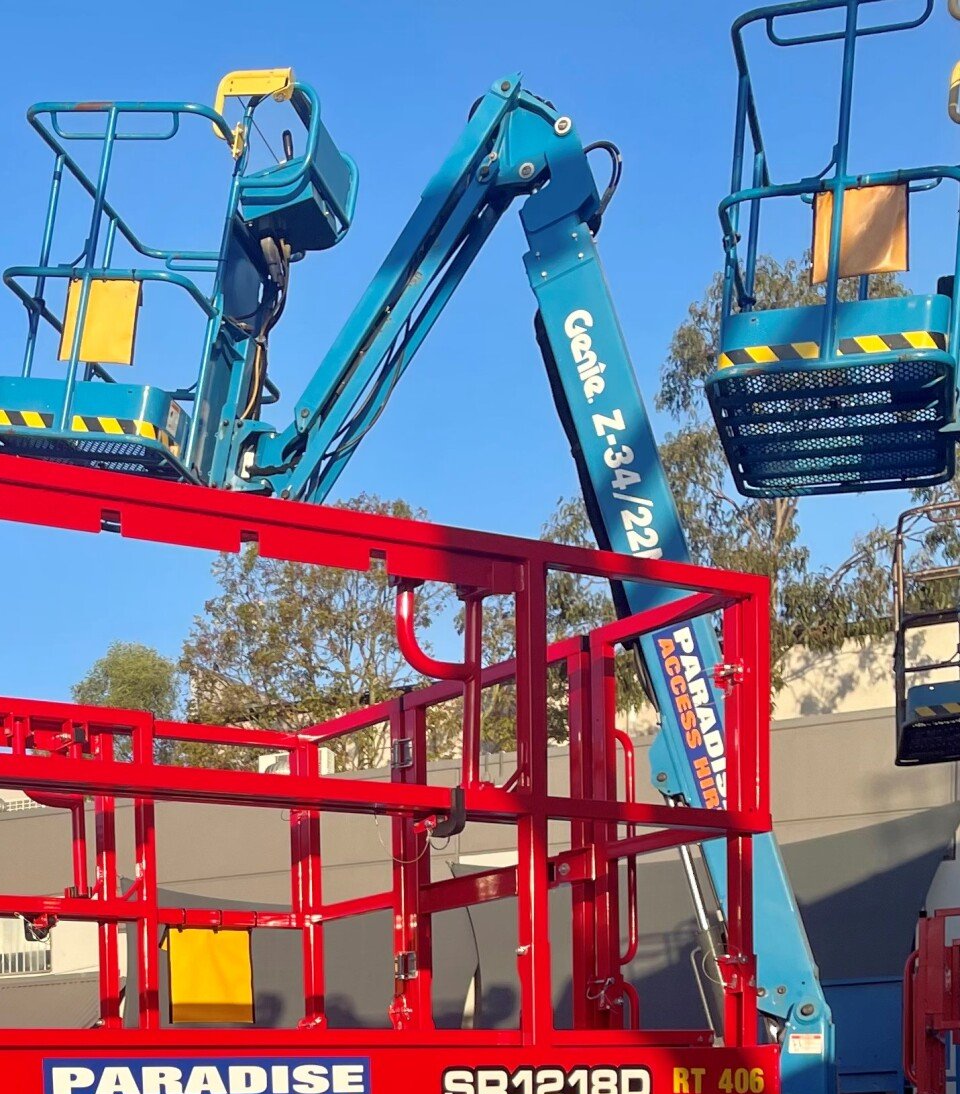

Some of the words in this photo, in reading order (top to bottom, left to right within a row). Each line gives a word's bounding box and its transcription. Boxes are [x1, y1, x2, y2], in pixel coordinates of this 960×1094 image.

[564, 309, 607, 404] Genie
[592, 408, 663, 560] Z-34/22
[657, 638, 702, 749] ACCESS
[693, 756, 723, 810] HIR
[673, 1067, 706, 1094] RT
[718, 1067, 765, 1094] 406
